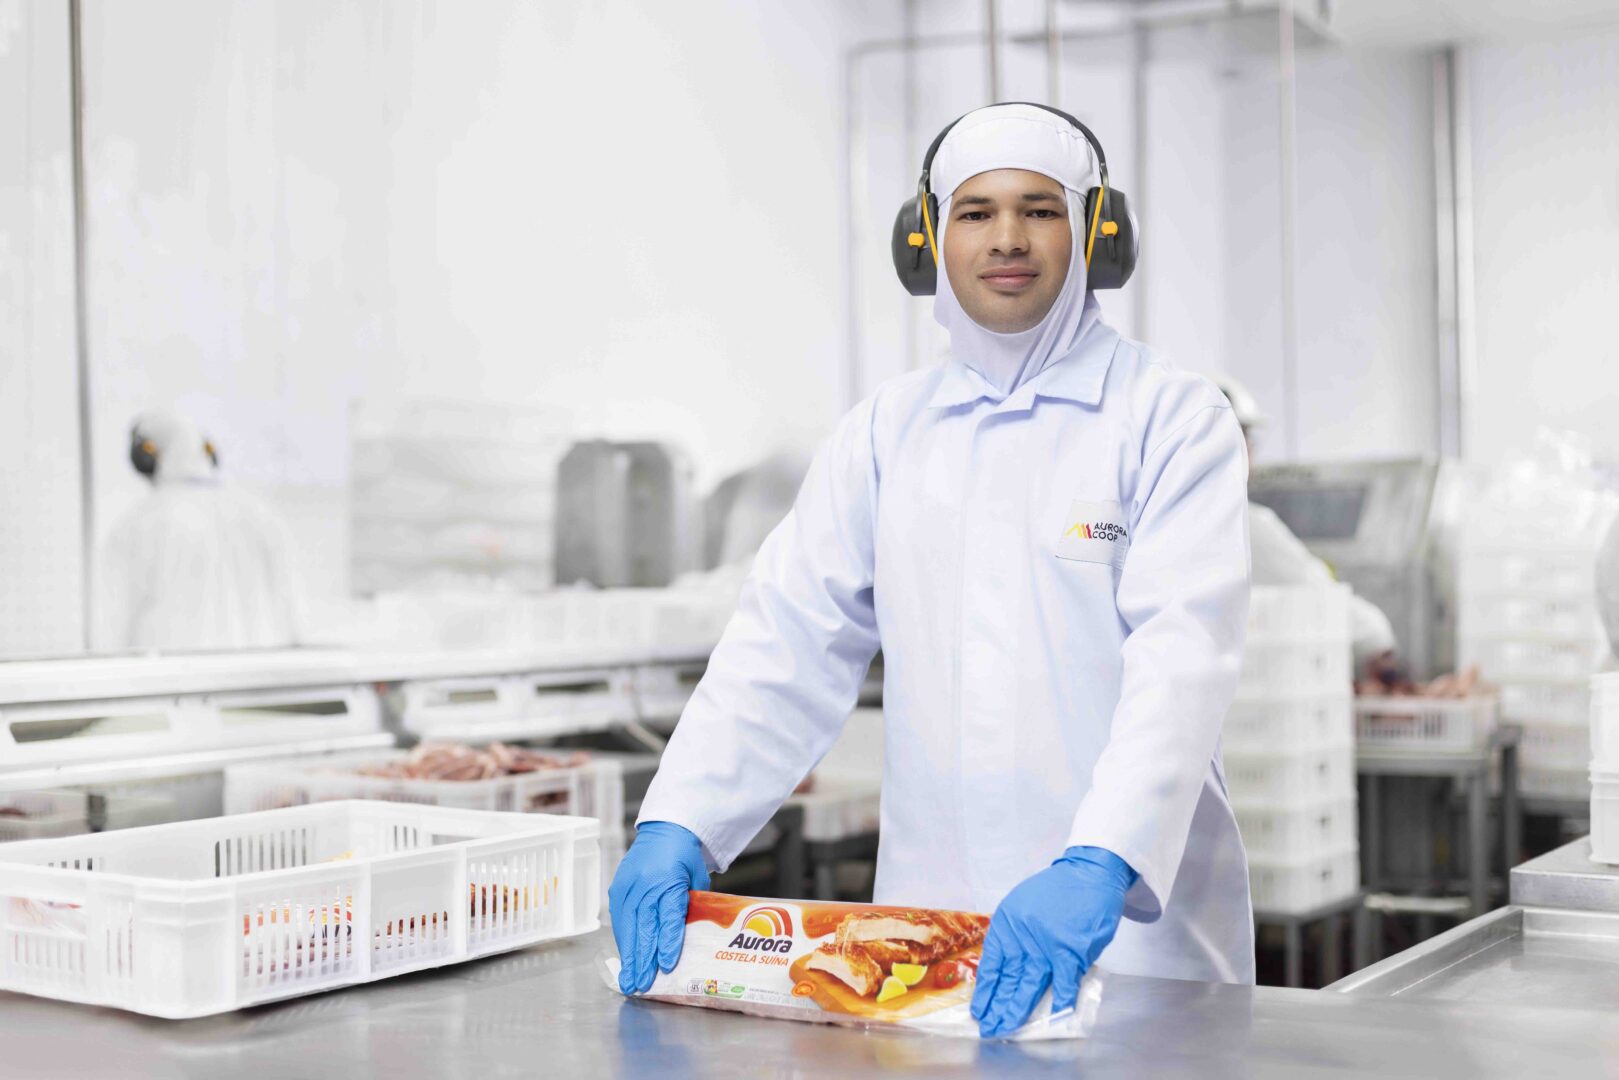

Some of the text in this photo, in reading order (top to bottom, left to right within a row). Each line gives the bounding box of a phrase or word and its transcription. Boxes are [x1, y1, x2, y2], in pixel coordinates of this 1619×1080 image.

[1092, 531, 1118, 542] COOP
[1094, 522, 1127, 538] AURORA
[728, 933, 793, 953] Aurora
[715, 951, 789, 966] COSTELA SUÍNA
